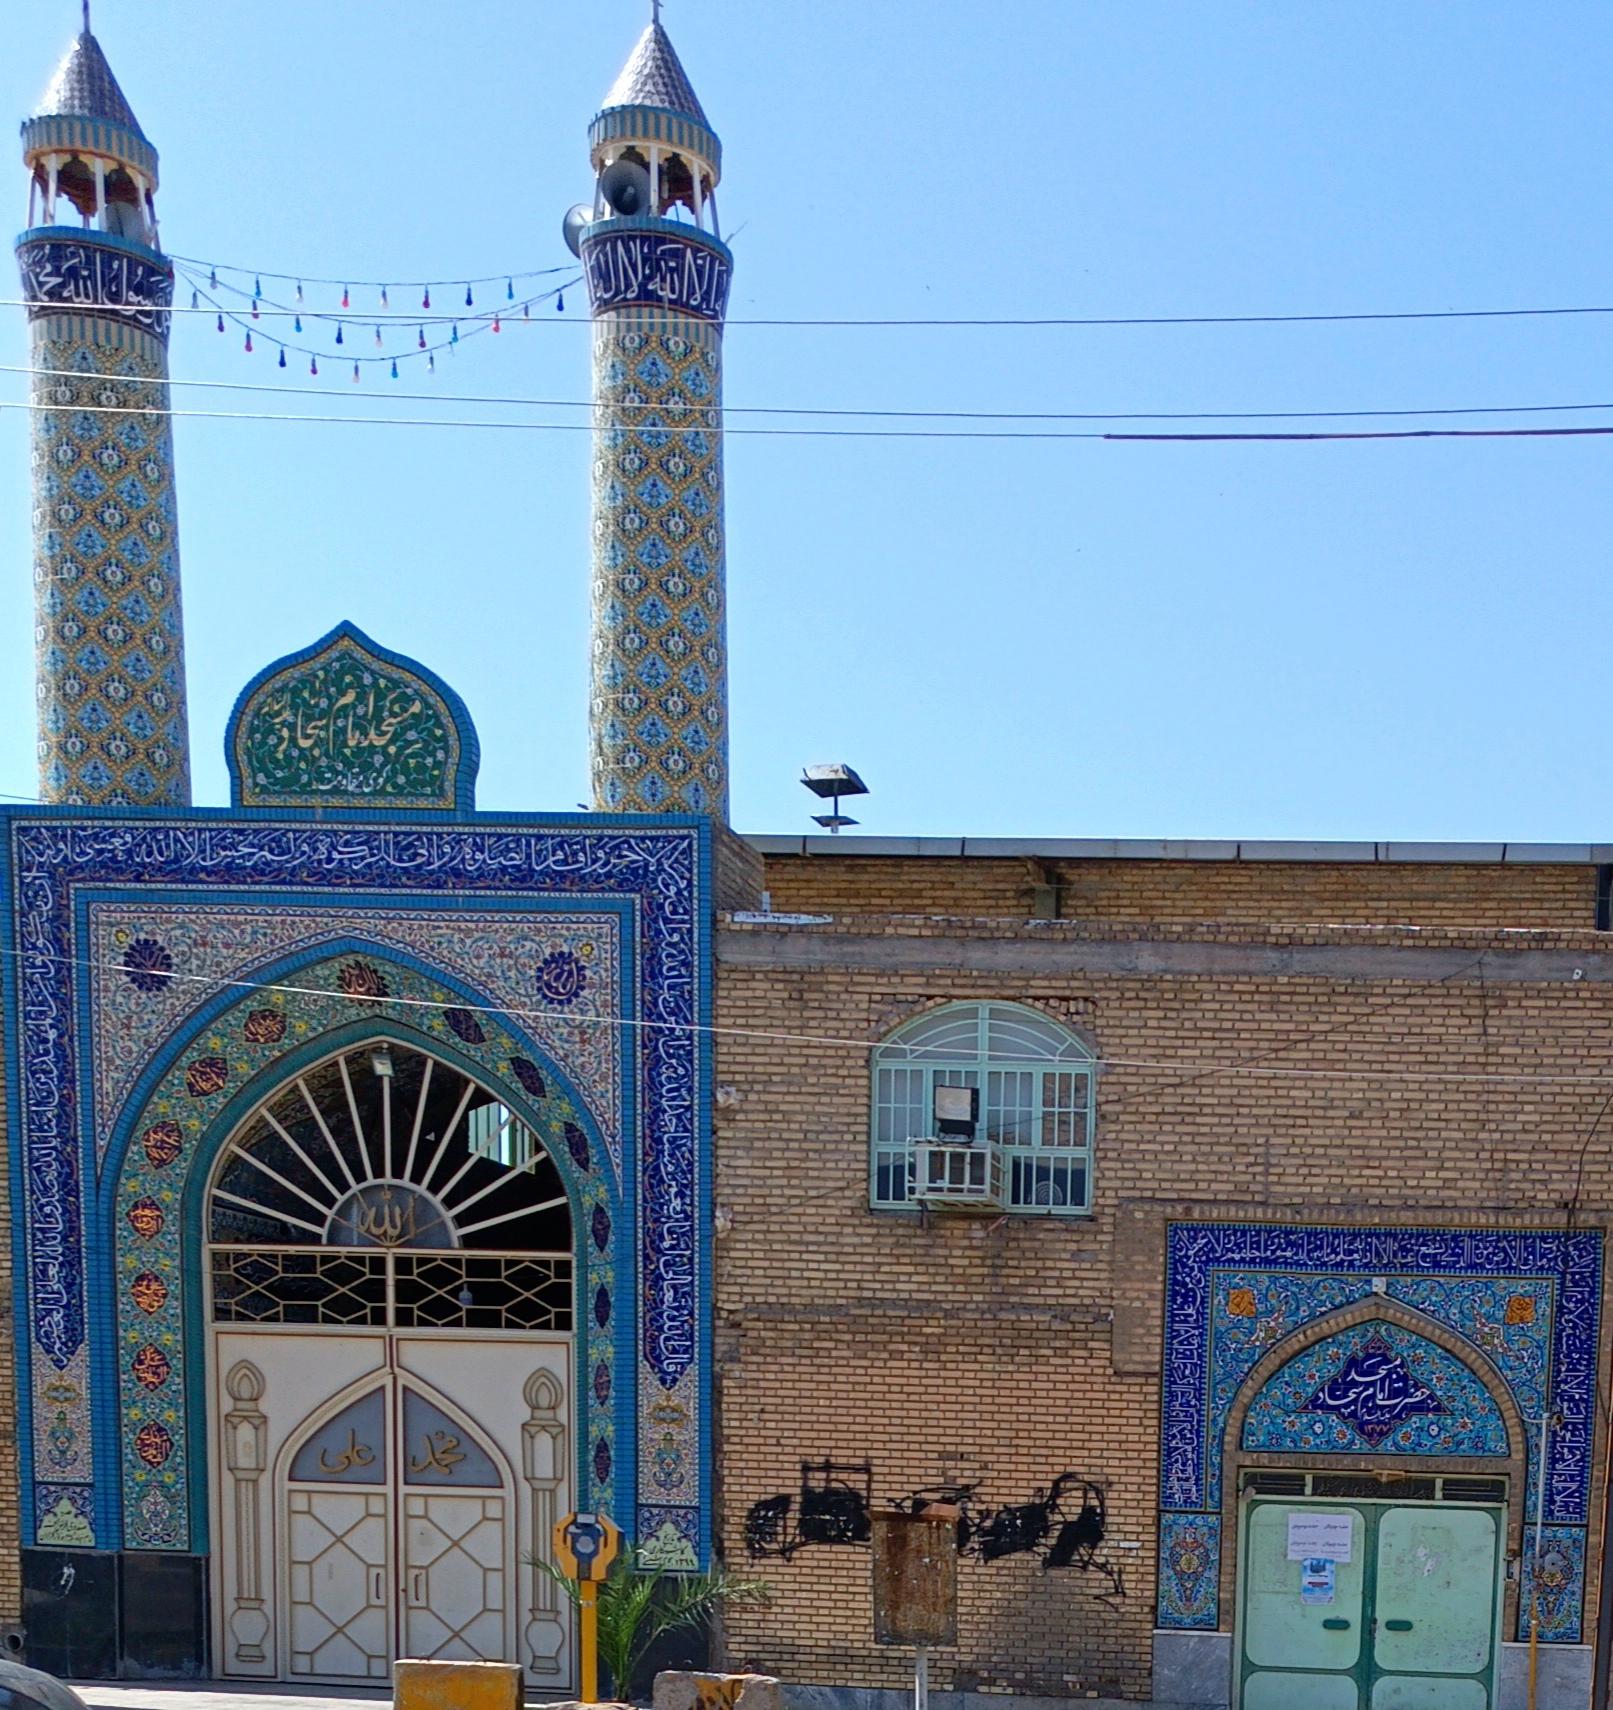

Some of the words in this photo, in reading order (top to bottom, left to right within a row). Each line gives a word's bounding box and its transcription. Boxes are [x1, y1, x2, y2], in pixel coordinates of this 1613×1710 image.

[359, 1190, 416, 1239] الله
[1346, 1356, 1402, 1383] مسجد
[1316, 1383, 1366, 1411] سجاد
[1376, 1382, 1432, 1416] حضرت
[411, 1429, 467, 1475] محمد
